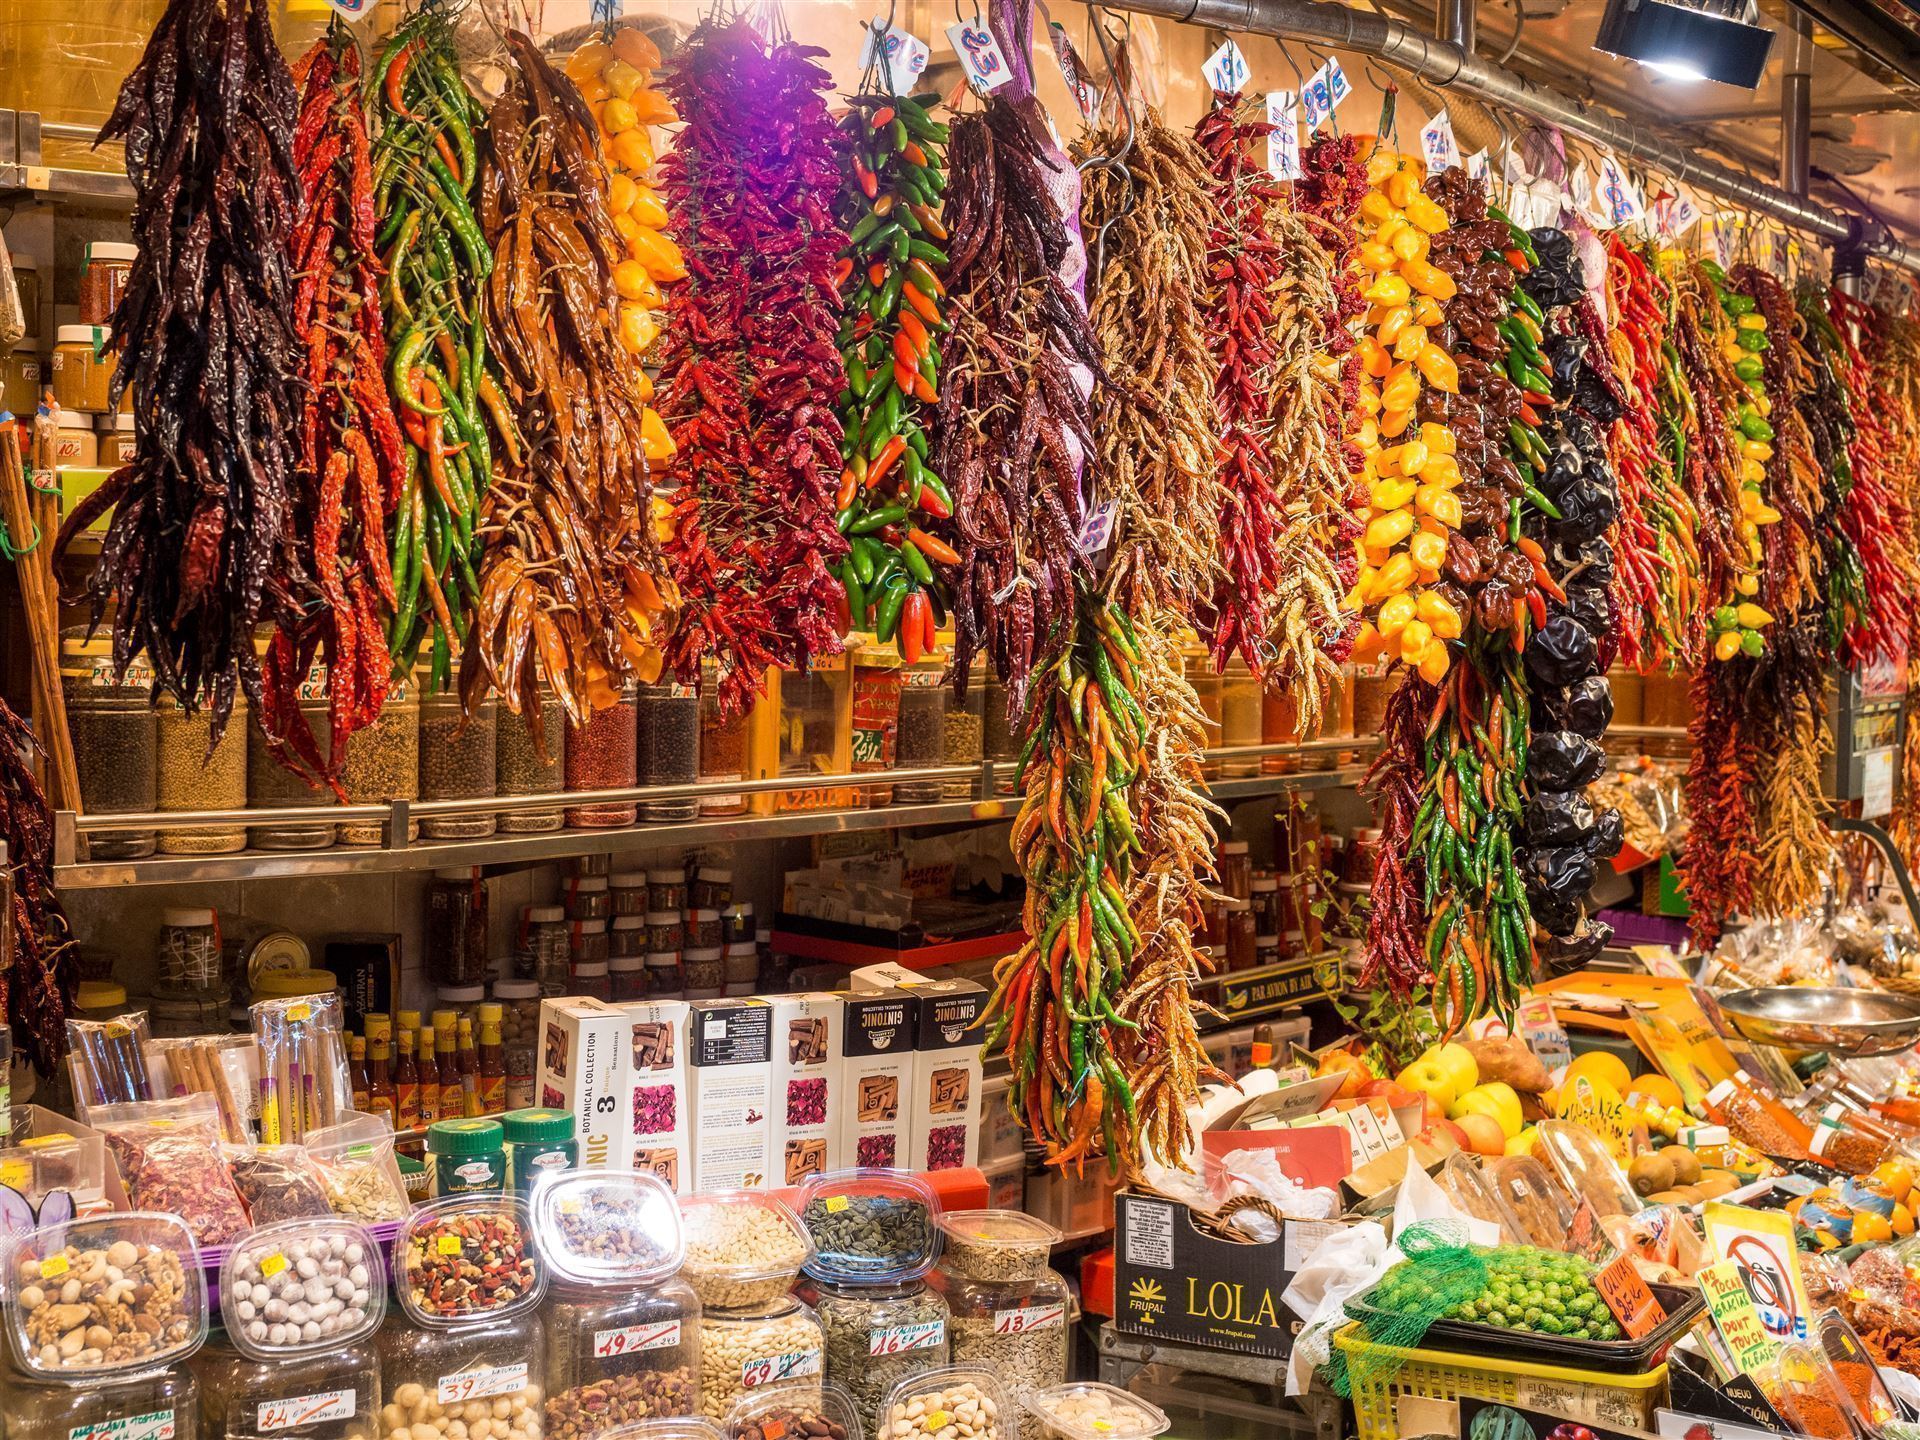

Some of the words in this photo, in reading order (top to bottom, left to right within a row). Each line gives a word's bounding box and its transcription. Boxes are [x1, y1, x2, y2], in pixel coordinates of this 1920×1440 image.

[93, 669, 150, 679] PIENTA
[1252, 986, 1266, 1001] PAR
[1266, 981, 1288, 999] AVION
[1289, 978, 1299, 993] BY
[1300, 974, 1313, 990] AIR
[862, 1011, 903, 1028] GINTONIC
[935, 1005, 975, 1022] GINTONIC
[585, 1032, 596, 1084] COLLECTION
[611, 1031, 619, 1071] Sensations
[603, 1066, 611, 1093] Unique
[582, 1087, 593, 1134] BOTANICAL
[597, 1095, 616, 1113] 3
[585, 1133, 609, 1168] NIC
[1701, 1269, 1716, 1283] NO
[1711, 1277, 1742, 1295] TOCAR
[1130, 1299, 1165, 1314] FRUPAL
[1186, 1276, 1280, 1328] LOLA
[996, 1315, 1024, 1333] 13
[1209, 1327, 1256, 1340] www.frupal.com
[1722, 1316, 1750, 1335] DONT
[1731, 1330, 1764, 1352] TOUCH
[1741, 1344, 1776, 1371] PLEASE
[743, 1363, 771, 1387] 69
[444, 1379, 474, 1403] 39
[1527, 1383, 1536, 1392] El
[1538, 1384, 1573, 1398] Obrador
[1725, 1387, 1752, 1400] NUEVO
